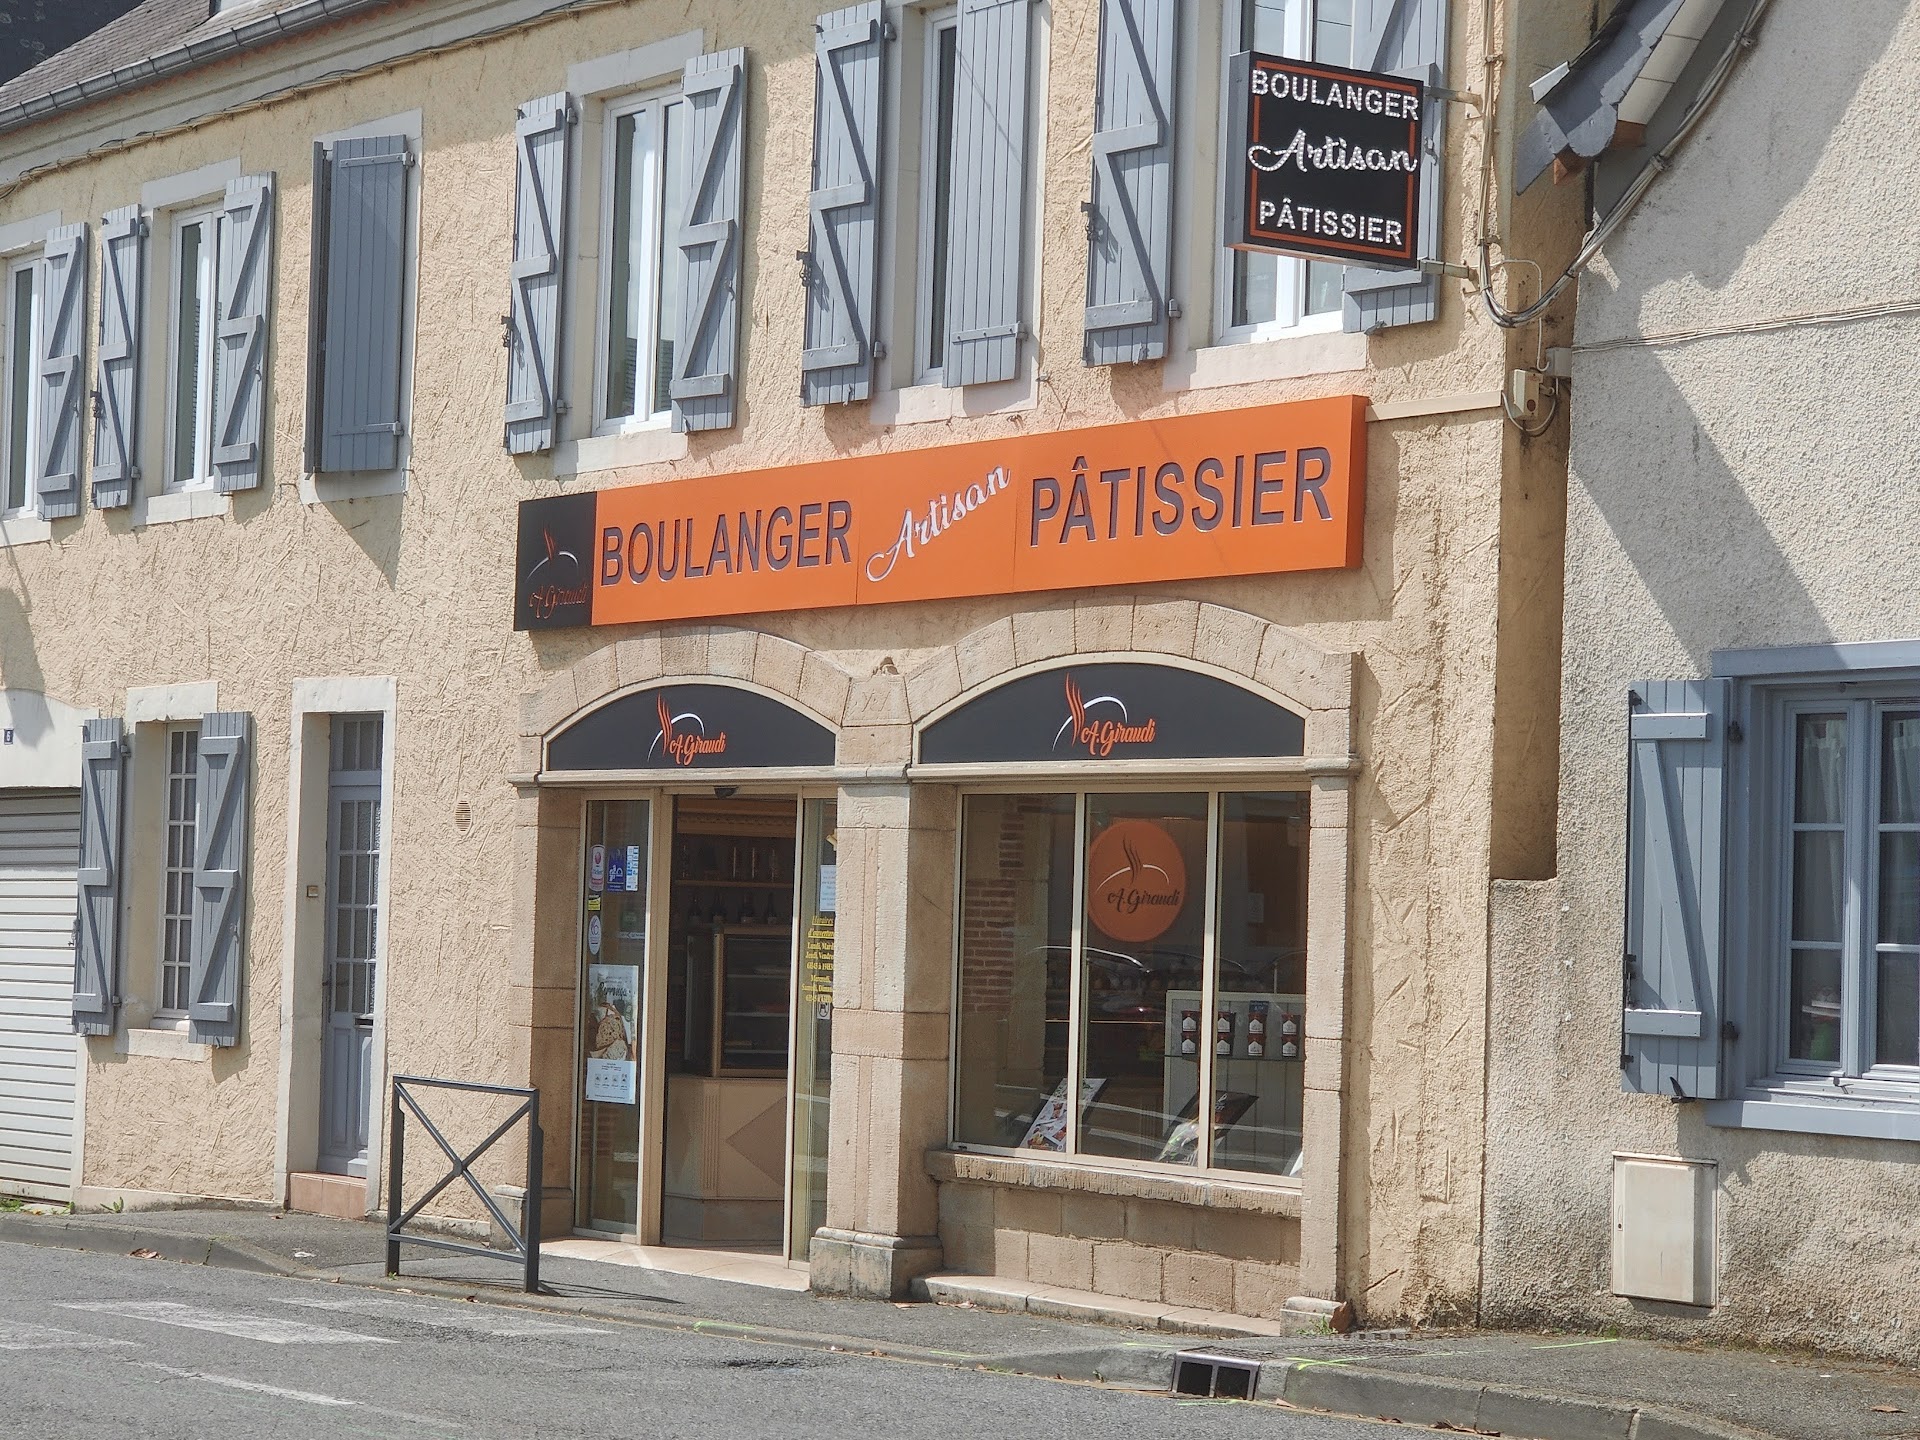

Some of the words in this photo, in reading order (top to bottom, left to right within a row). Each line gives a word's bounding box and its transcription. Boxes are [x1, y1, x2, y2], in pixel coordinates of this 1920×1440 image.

[1251, 69, 1419, 121] BOULANGER
[1248, 129, 1418, 173] Artisan
[1259, 197, 1402, 246] PÂTISSIER
[600, 499, 853, 588] BOULANGER
[865, 464, 1012, 583] Artisan
[1030, 446, 1333, 548] PÂTISSIER
[6, 730, 11, 742] 6
[669, 731, 727, 766] A.Giraudi
[1080, 718, 1156, 757] A.Giraudi
